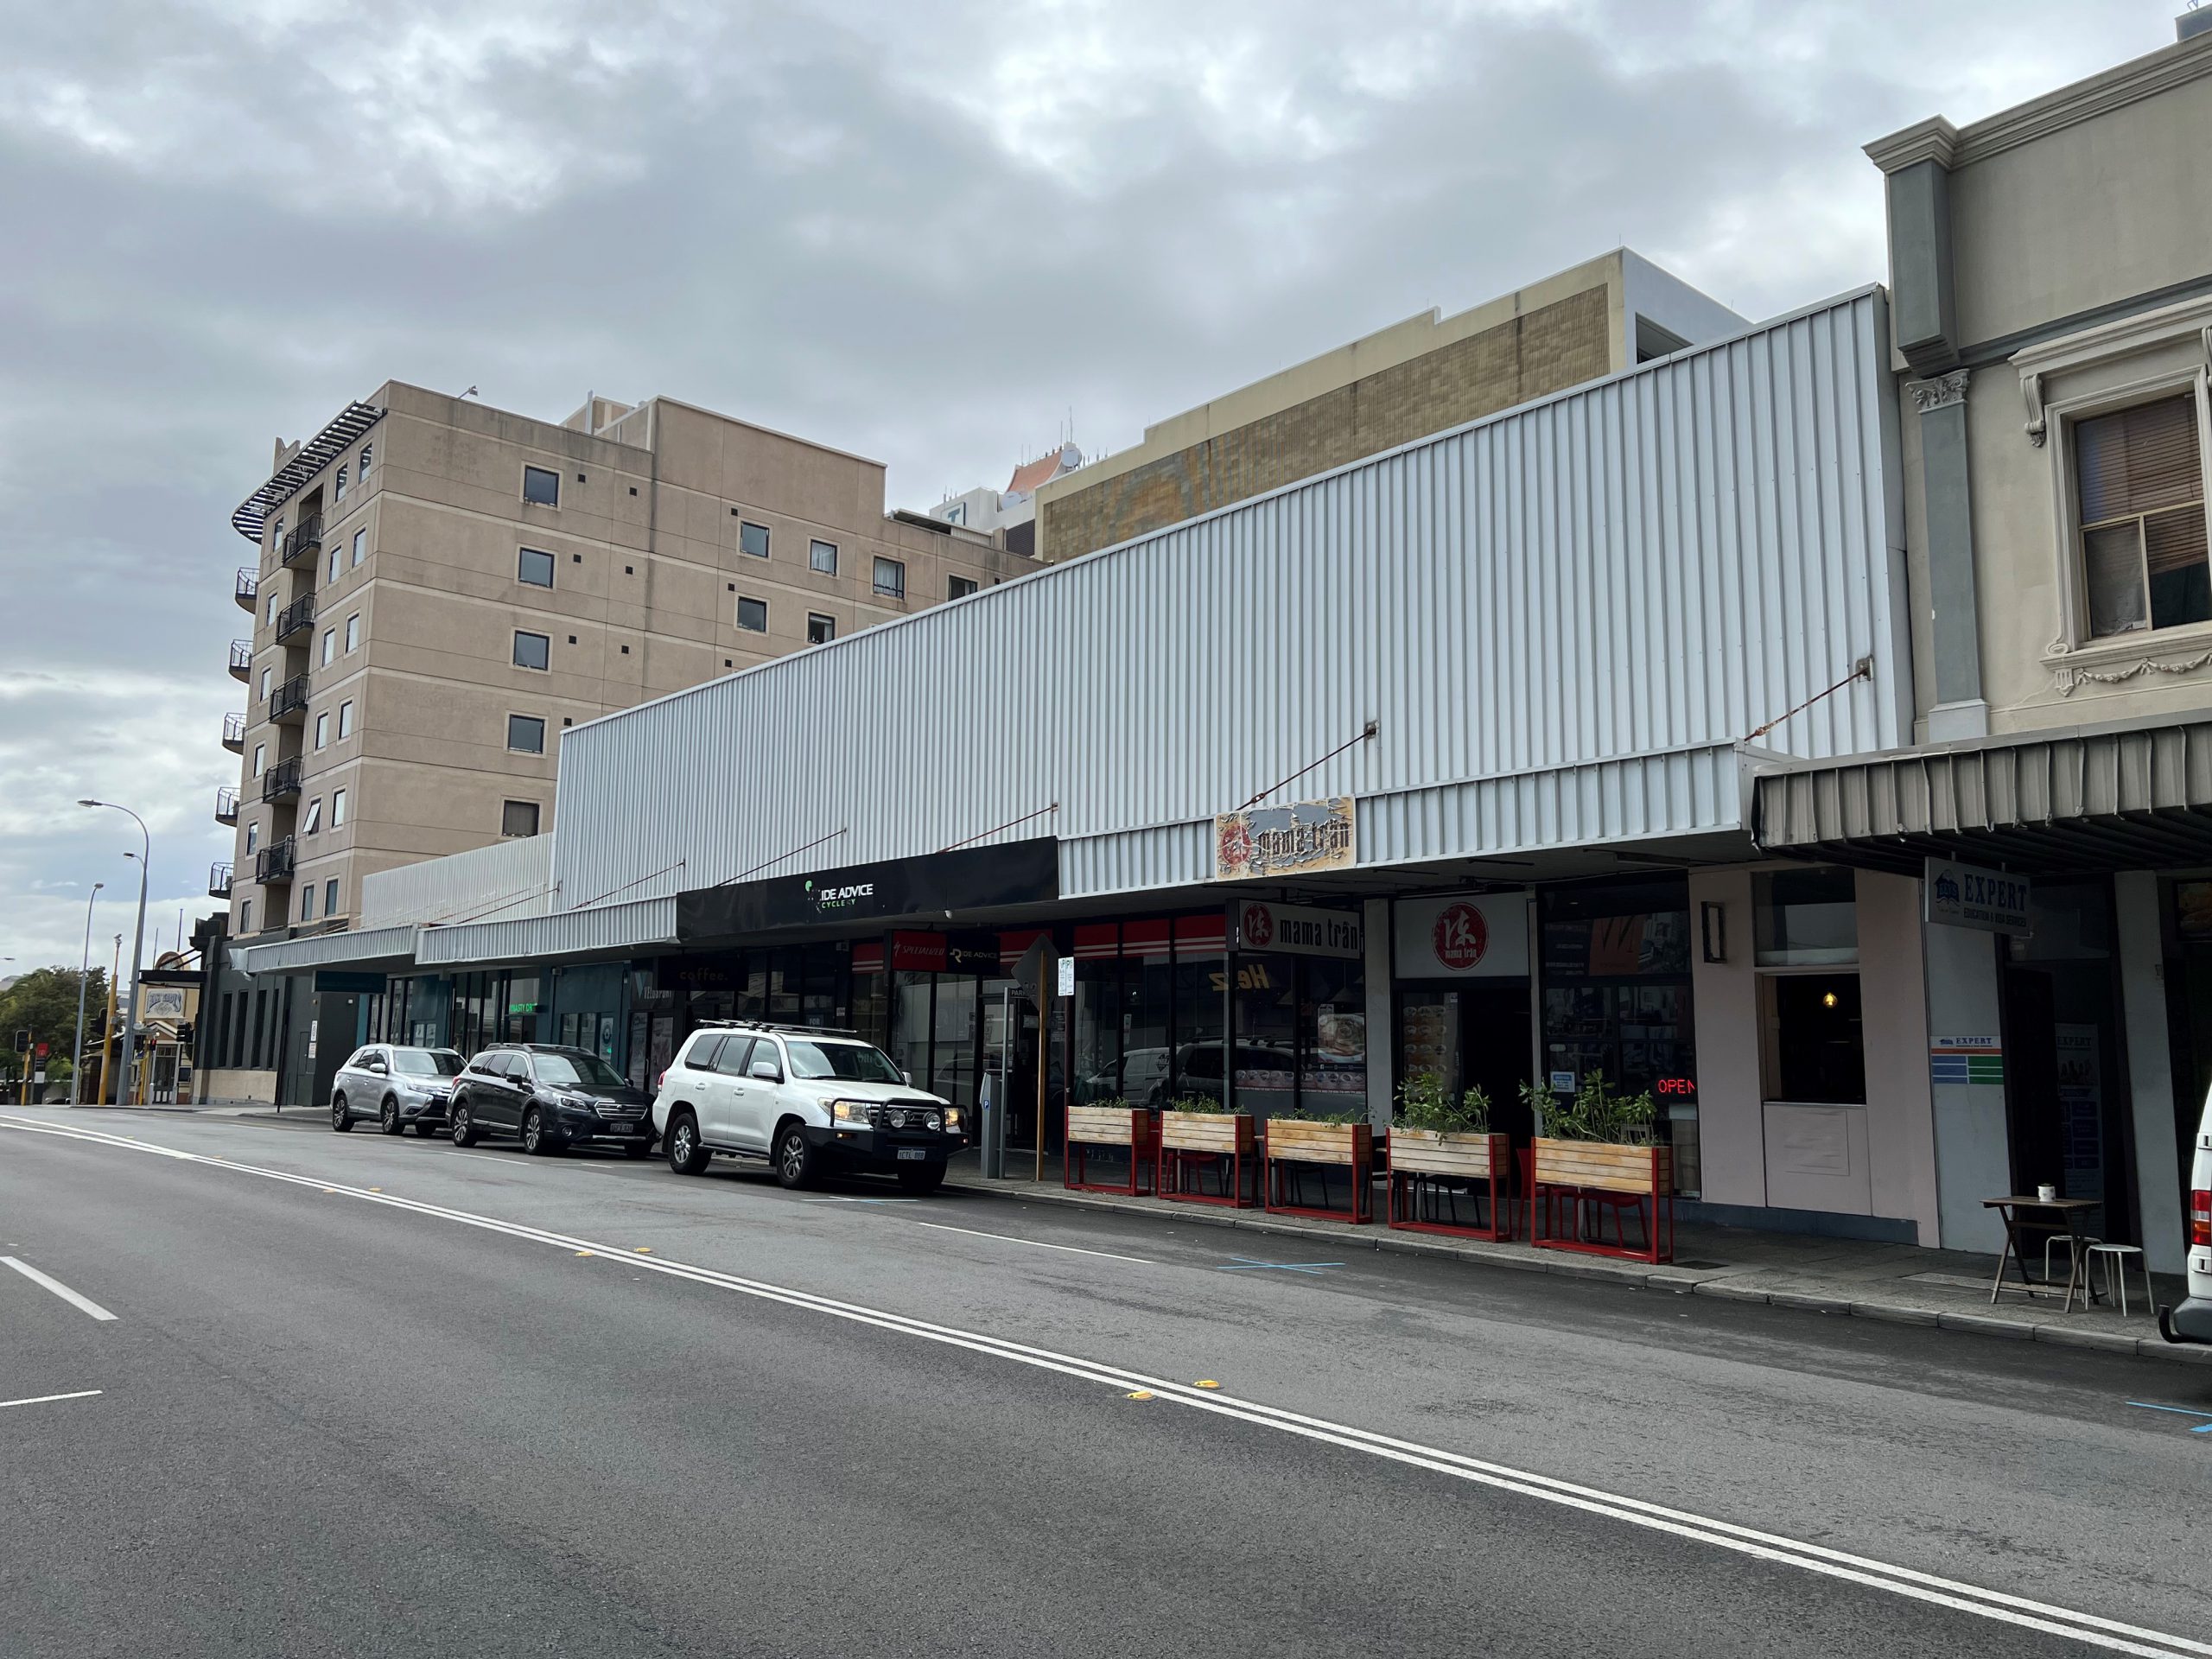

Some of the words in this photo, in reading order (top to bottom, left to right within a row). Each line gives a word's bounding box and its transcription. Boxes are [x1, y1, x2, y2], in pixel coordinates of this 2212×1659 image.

[838, 883, 874, 899] ADVICE
[1964, 874, 2027, 912] EXPERT
[1280, 918, 1322, 946] mama
[902, 945, 945, 956] SPECIALIZED
[1445, 950, 1462, 959] mama
[679, 967, 728, 982] coffee.
[2057, 1037, 2092, 1046] EXPERT
[1657, 1079, 1696, 1094] OPEN
